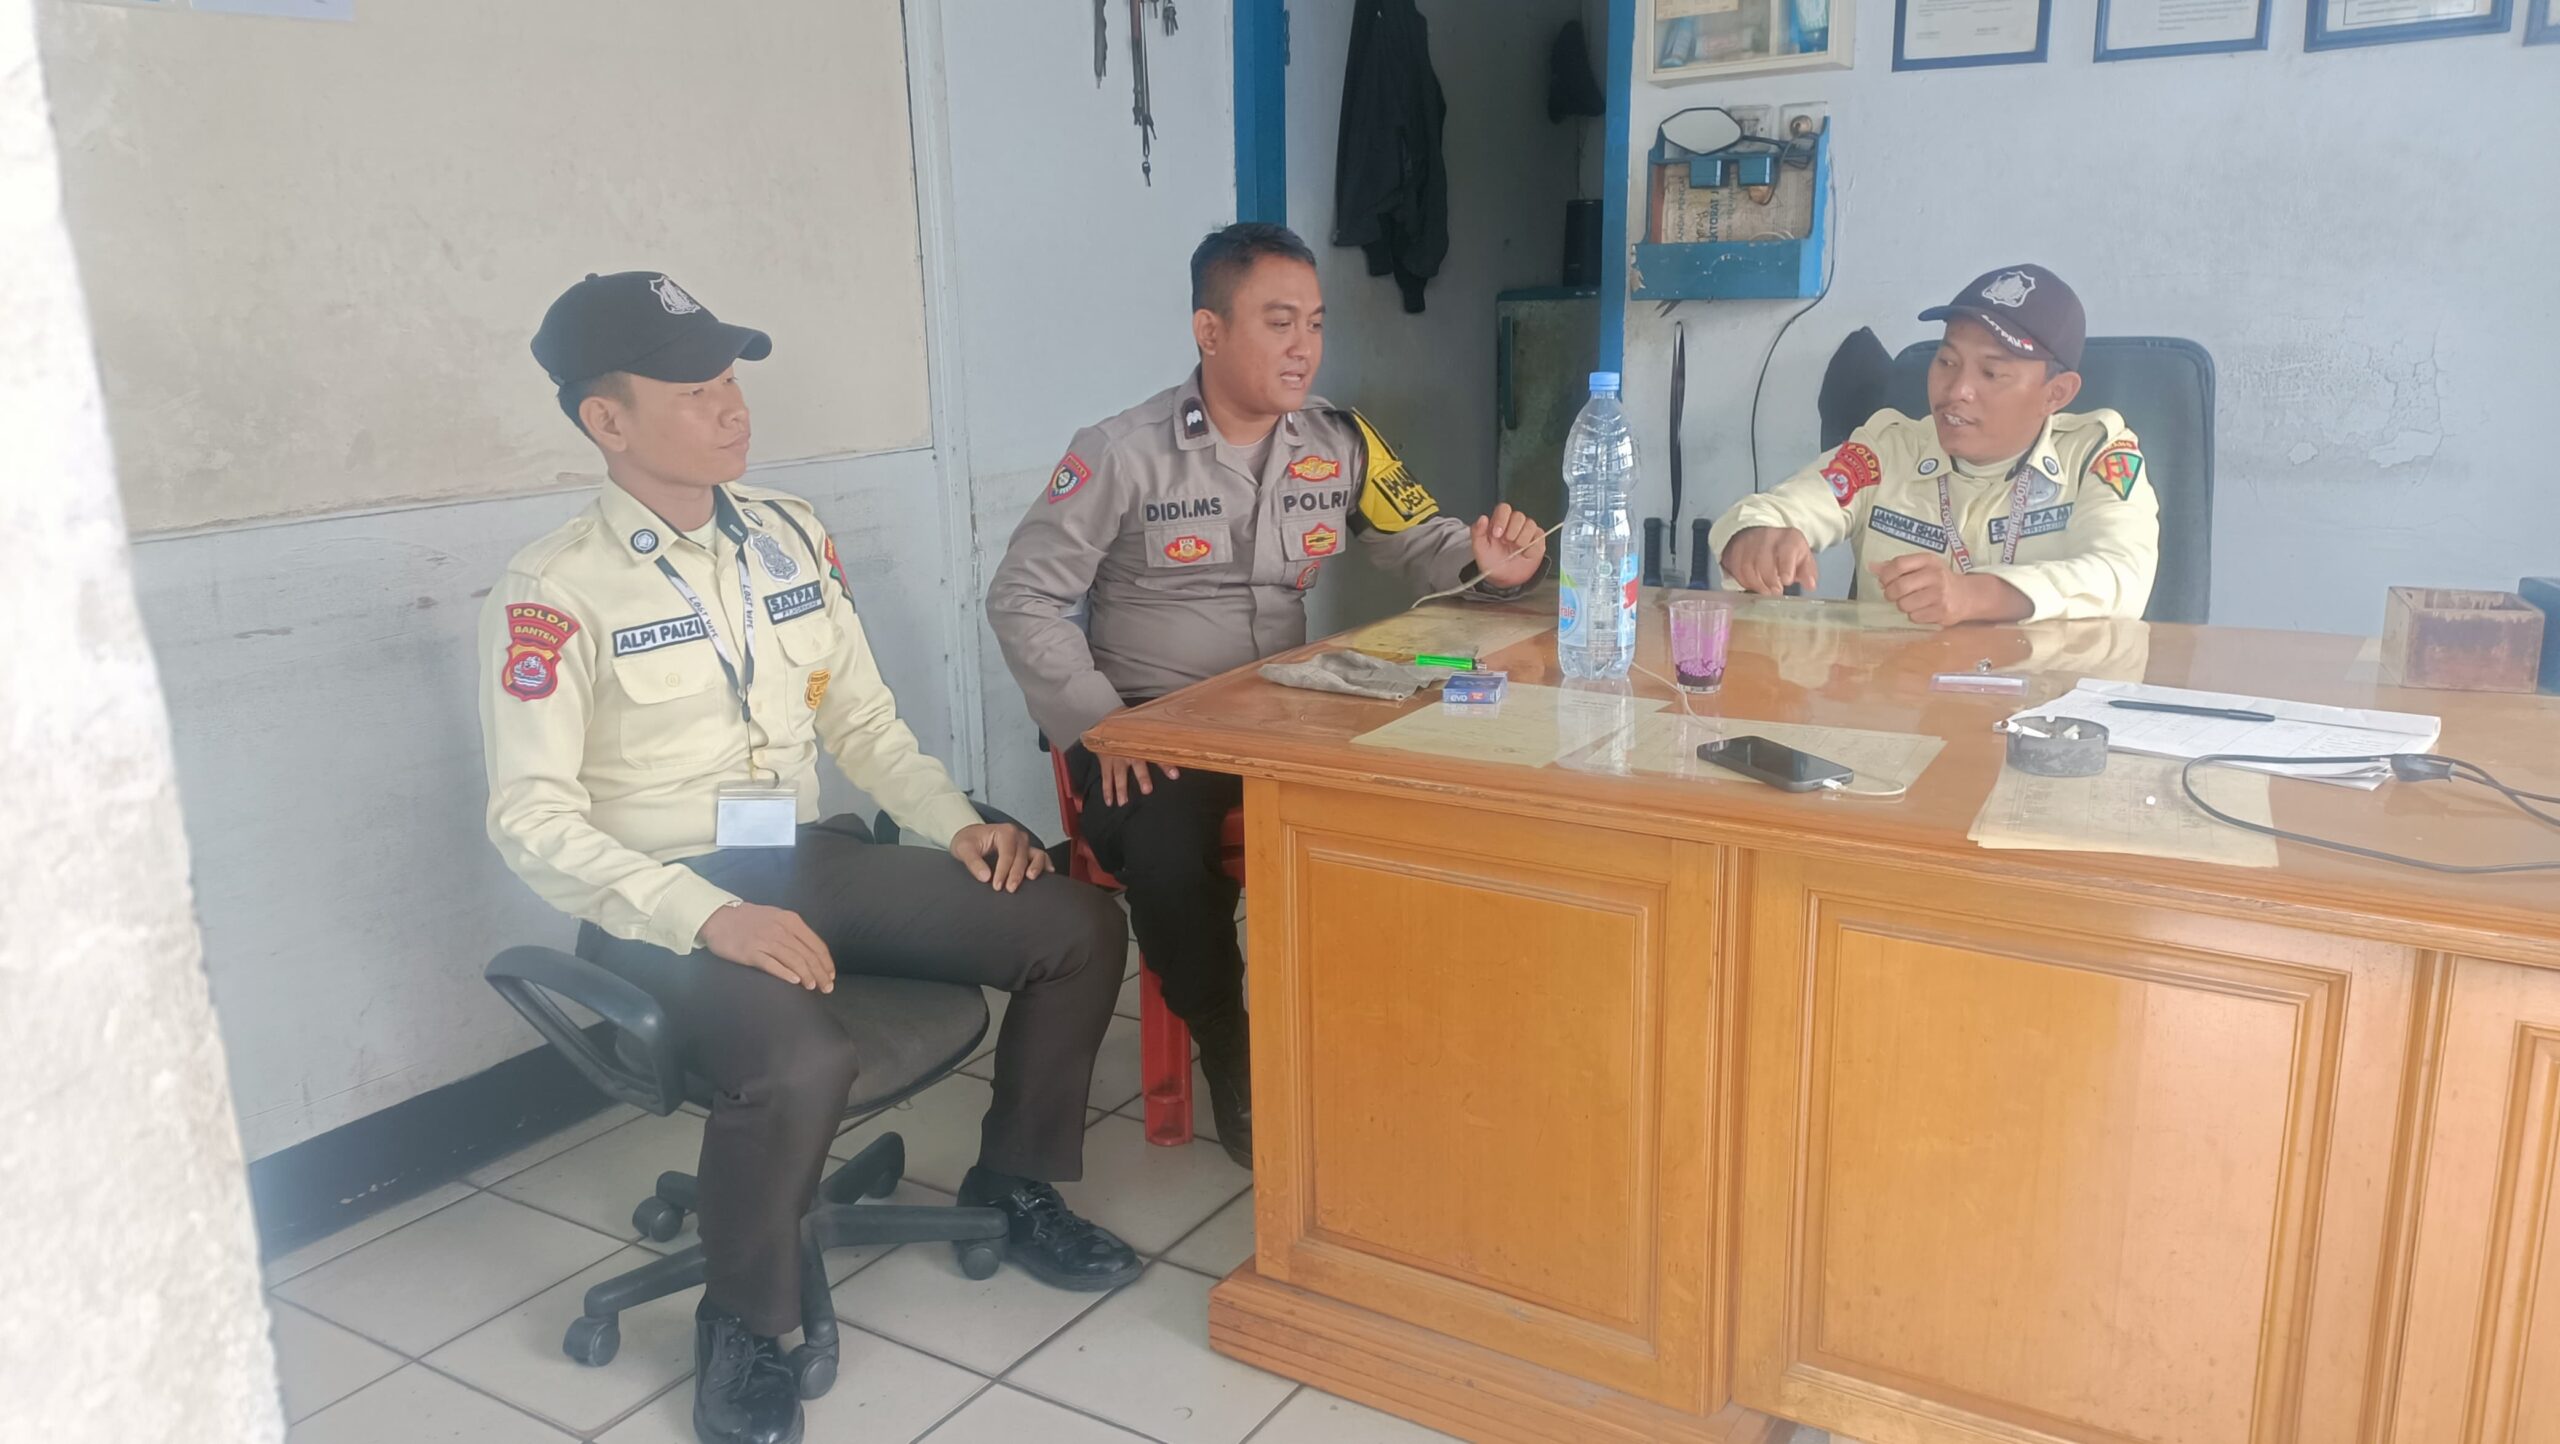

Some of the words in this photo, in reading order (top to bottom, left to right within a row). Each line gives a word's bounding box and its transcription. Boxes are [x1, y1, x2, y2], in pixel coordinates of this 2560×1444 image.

[1146, 497, 1222, 522] DIDI.MS
[1283, 490, 1348, 513] POLRI
[512, 607, 569, 632] POLDA
[514, 625, 559, 644] BANTEN
[620, 629, 657, 651] ALPI
[660, 619, 701, 642] PAIZI
